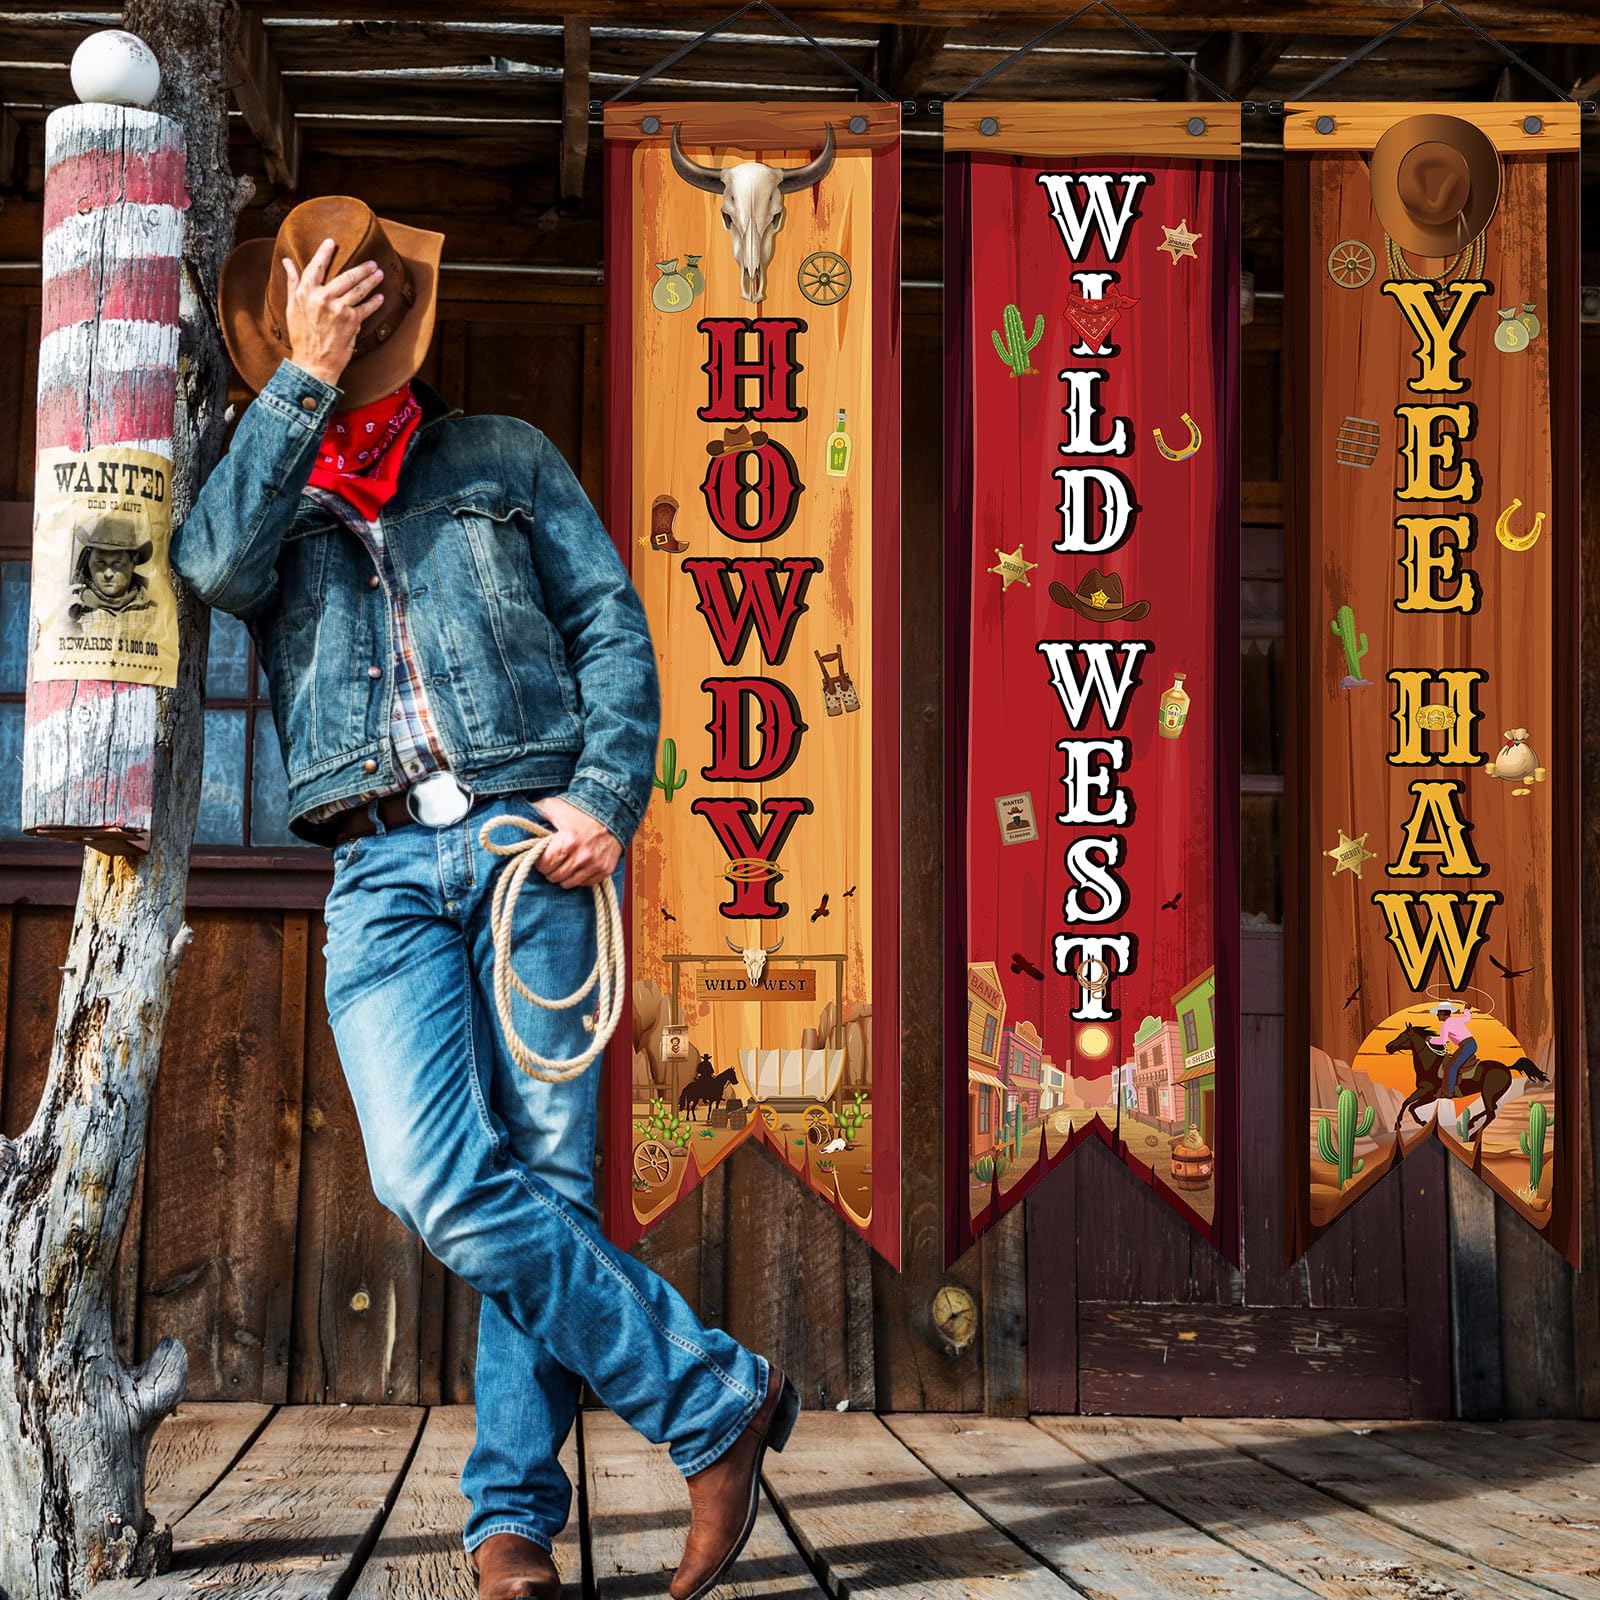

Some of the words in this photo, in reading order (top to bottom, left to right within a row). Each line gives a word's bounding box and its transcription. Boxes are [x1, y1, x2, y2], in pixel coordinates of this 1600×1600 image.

[53, 461, 165, 503] WANTED
[1380, 278, 1495, 616] YEE
[59, 637, 113, 651] REWARDS
[682, 317, 824, 920] HOWDY
[1035, 637, 1155, 1024] WEST
[1370, 667, 1504, 995] HAW
[704, 978, 748, 991] WILD
[763, 979, 808, 991] WEST
[970, 975, 1000, 1005] BANK
